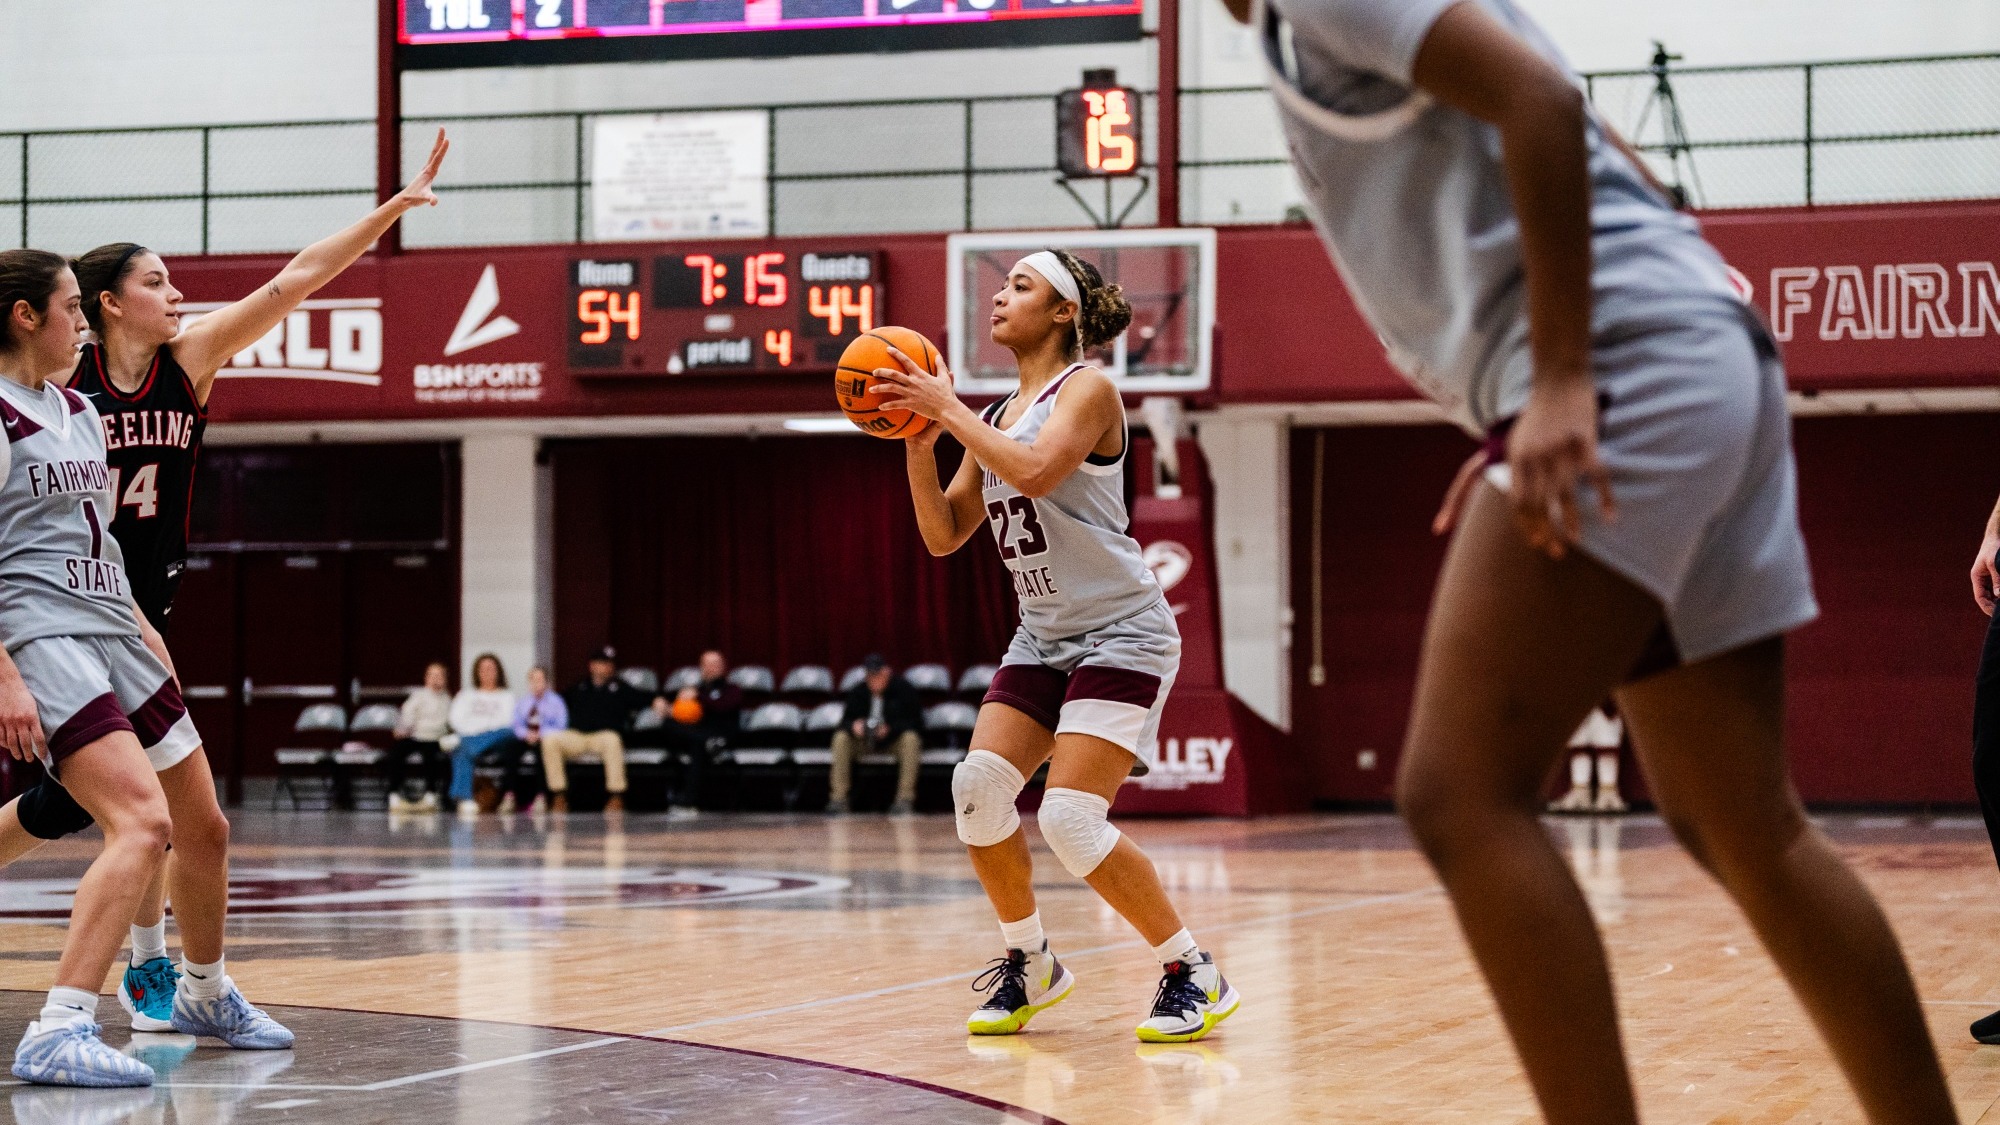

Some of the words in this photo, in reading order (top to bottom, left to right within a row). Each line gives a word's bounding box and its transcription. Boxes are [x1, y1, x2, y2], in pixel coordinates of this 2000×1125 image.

[1086, 113, 1134, 170] 15
[578, 260, 633, 286] Home
[685, 252, 787, 306] 7:15
[801, 253, 870, 280] Guests
[578, 290, 640, 344] 54
[808, 285, 874, 335] 44
[178, 308, 383, 373] RLD
[686, 338, 751, 368] period
[764, 329, 792, 366] 4
[109, 463, 158, 524] 14
[82, 498, 102, 560] 1
[987, 493, 1049, 561] 23
[66, 557, 122, 597] STATE
[1013, 566, 1058, 598] STATE
